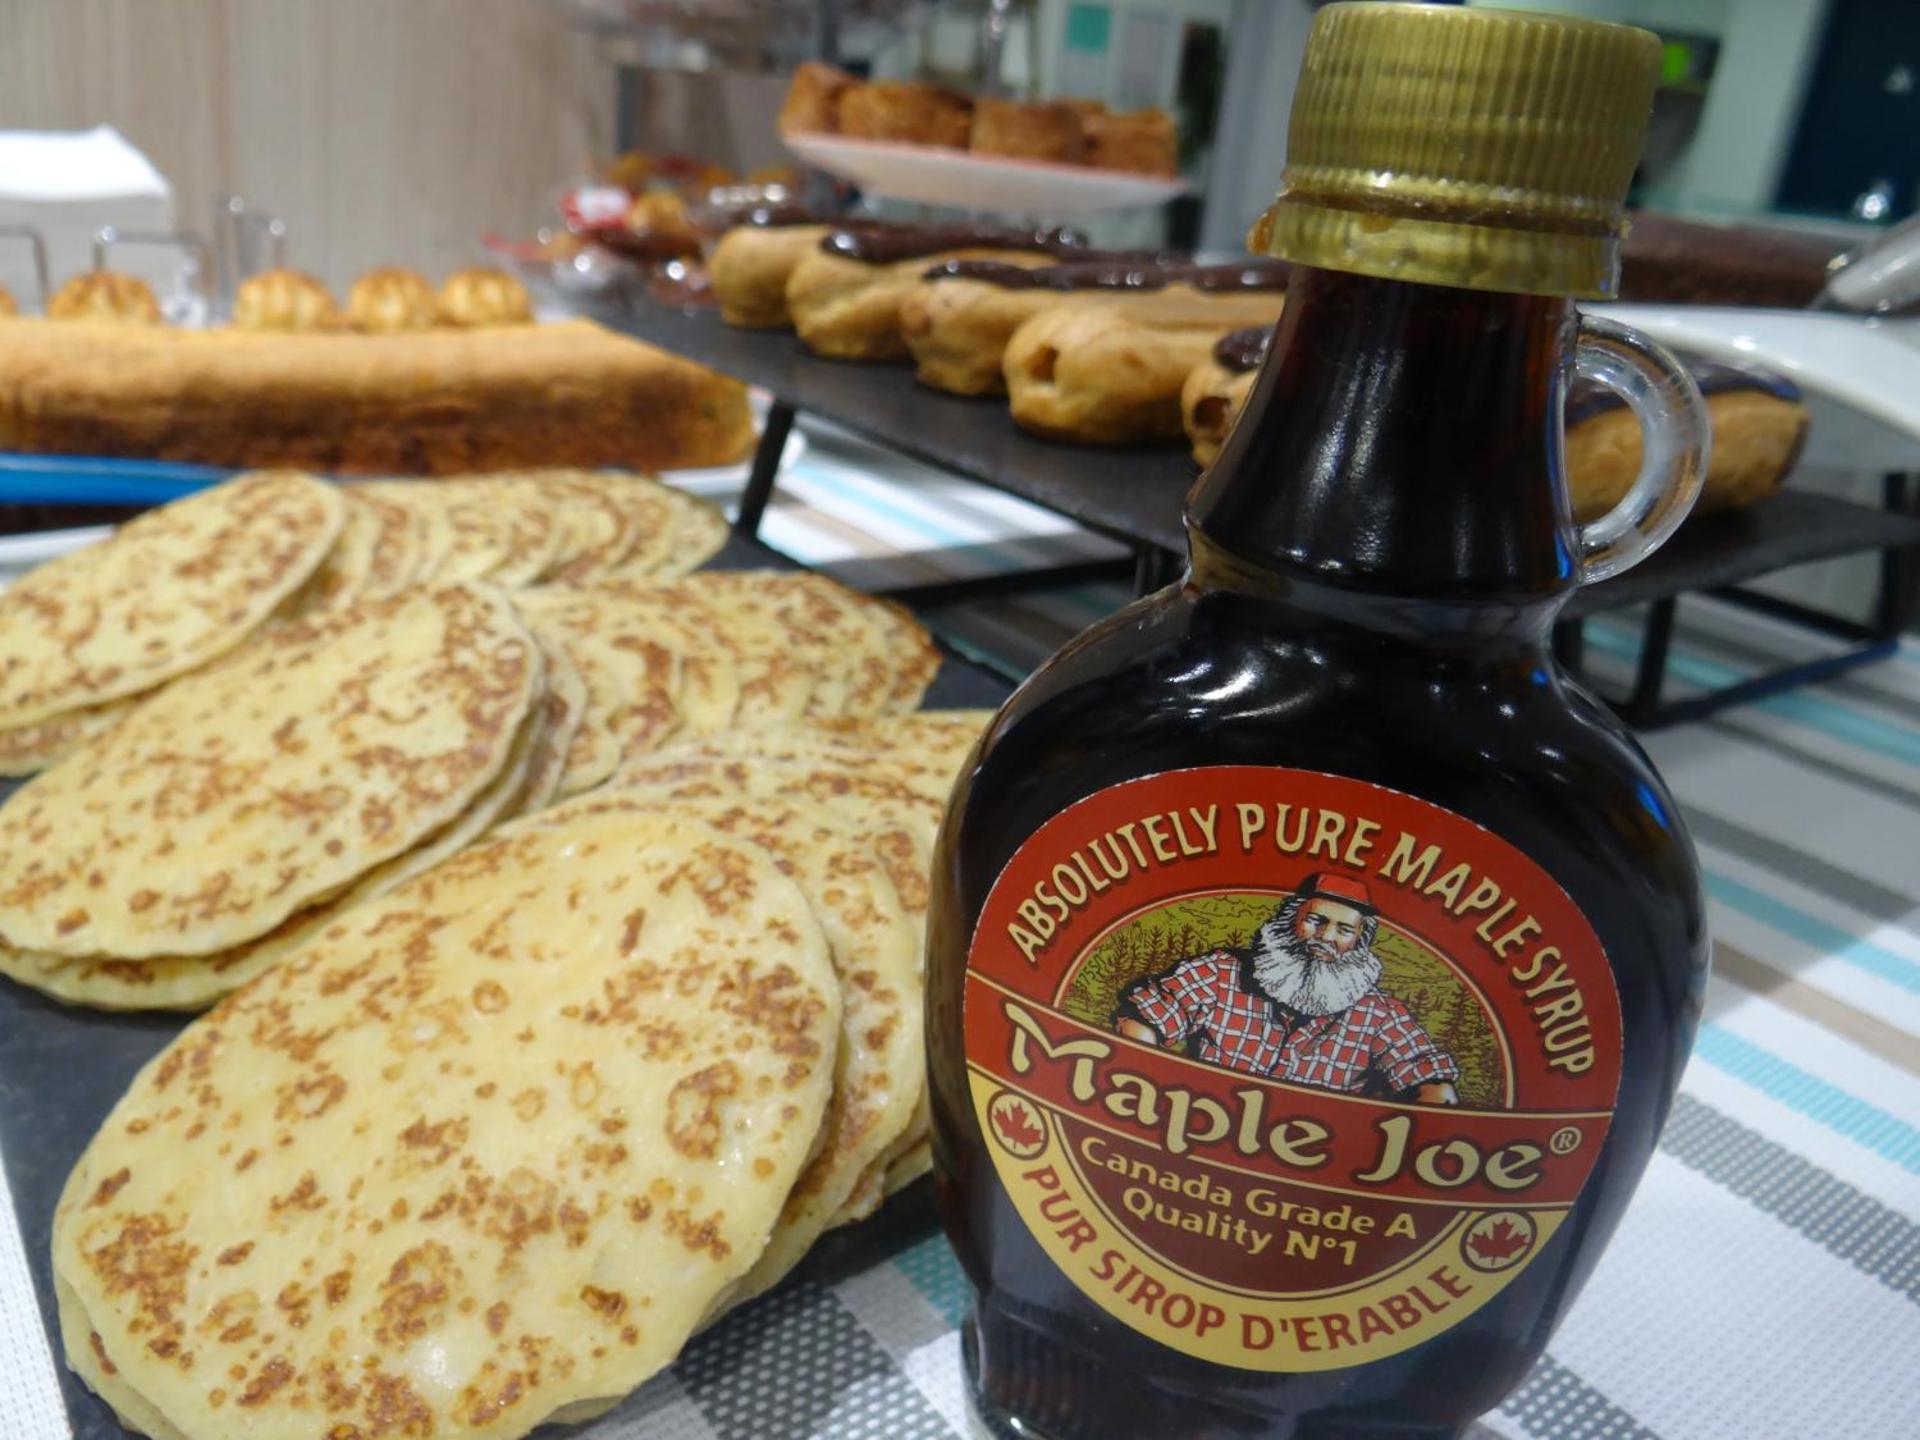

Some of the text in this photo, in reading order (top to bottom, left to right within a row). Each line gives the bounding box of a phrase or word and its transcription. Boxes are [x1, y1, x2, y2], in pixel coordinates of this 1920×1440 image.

[1007, 803, 1595, 1074] ABSOLUTELY PURE MAPLE SYRUP
[1005, 1003, 1329, 1167] Maple
[1022, 1164, 1473, 1352] PUR SIROP D'ERABLE
[1081, 1136, 1417, 1240] Canada Grade A
[1122, 1187, 1272, 1255] Quality
